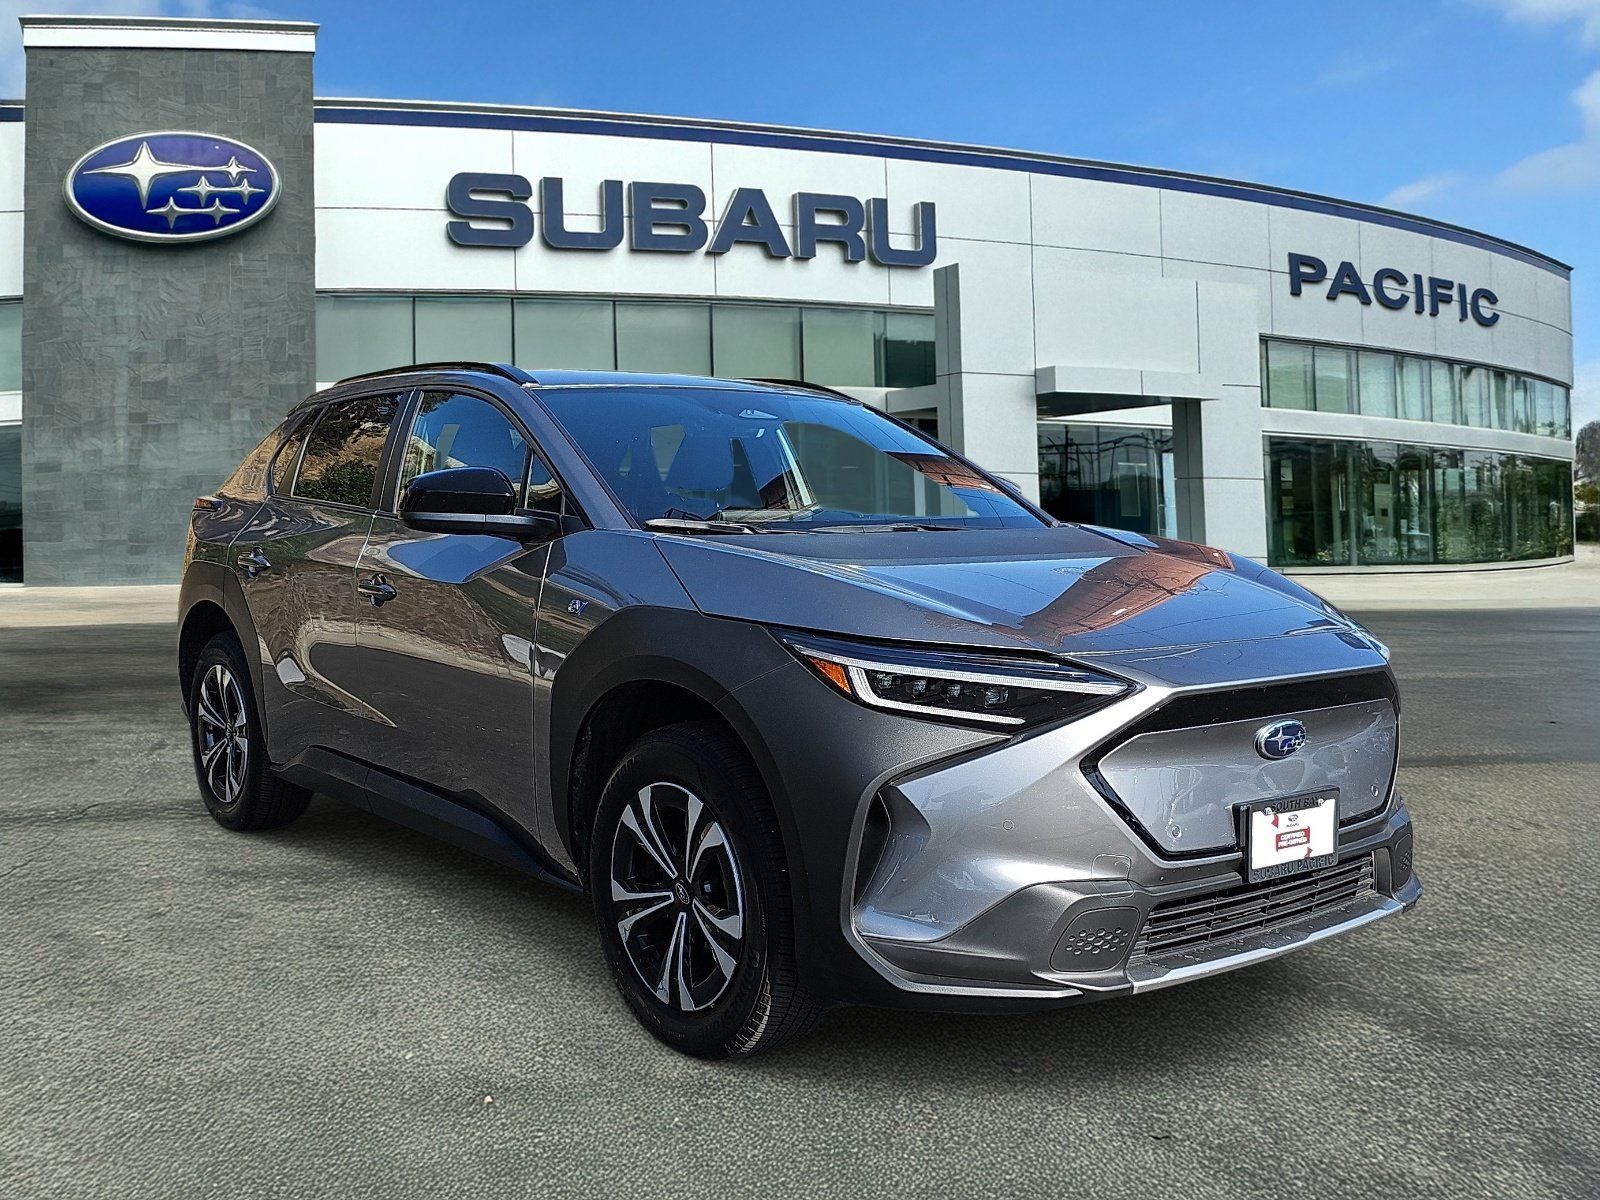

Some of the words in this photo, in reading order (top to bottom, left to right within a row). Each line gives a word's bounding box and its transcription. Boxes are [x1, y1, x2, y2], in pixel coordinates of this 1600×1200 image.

[447, 171, 937, 267] SUBARU
[1288, 252, 1500, 327] PACIFIC
[1271, 799, 1301, 813] SOUTH
[1253, 861, 1295, 880] SUBARU
[1297, 855, 1336, 872] PACIFIC
